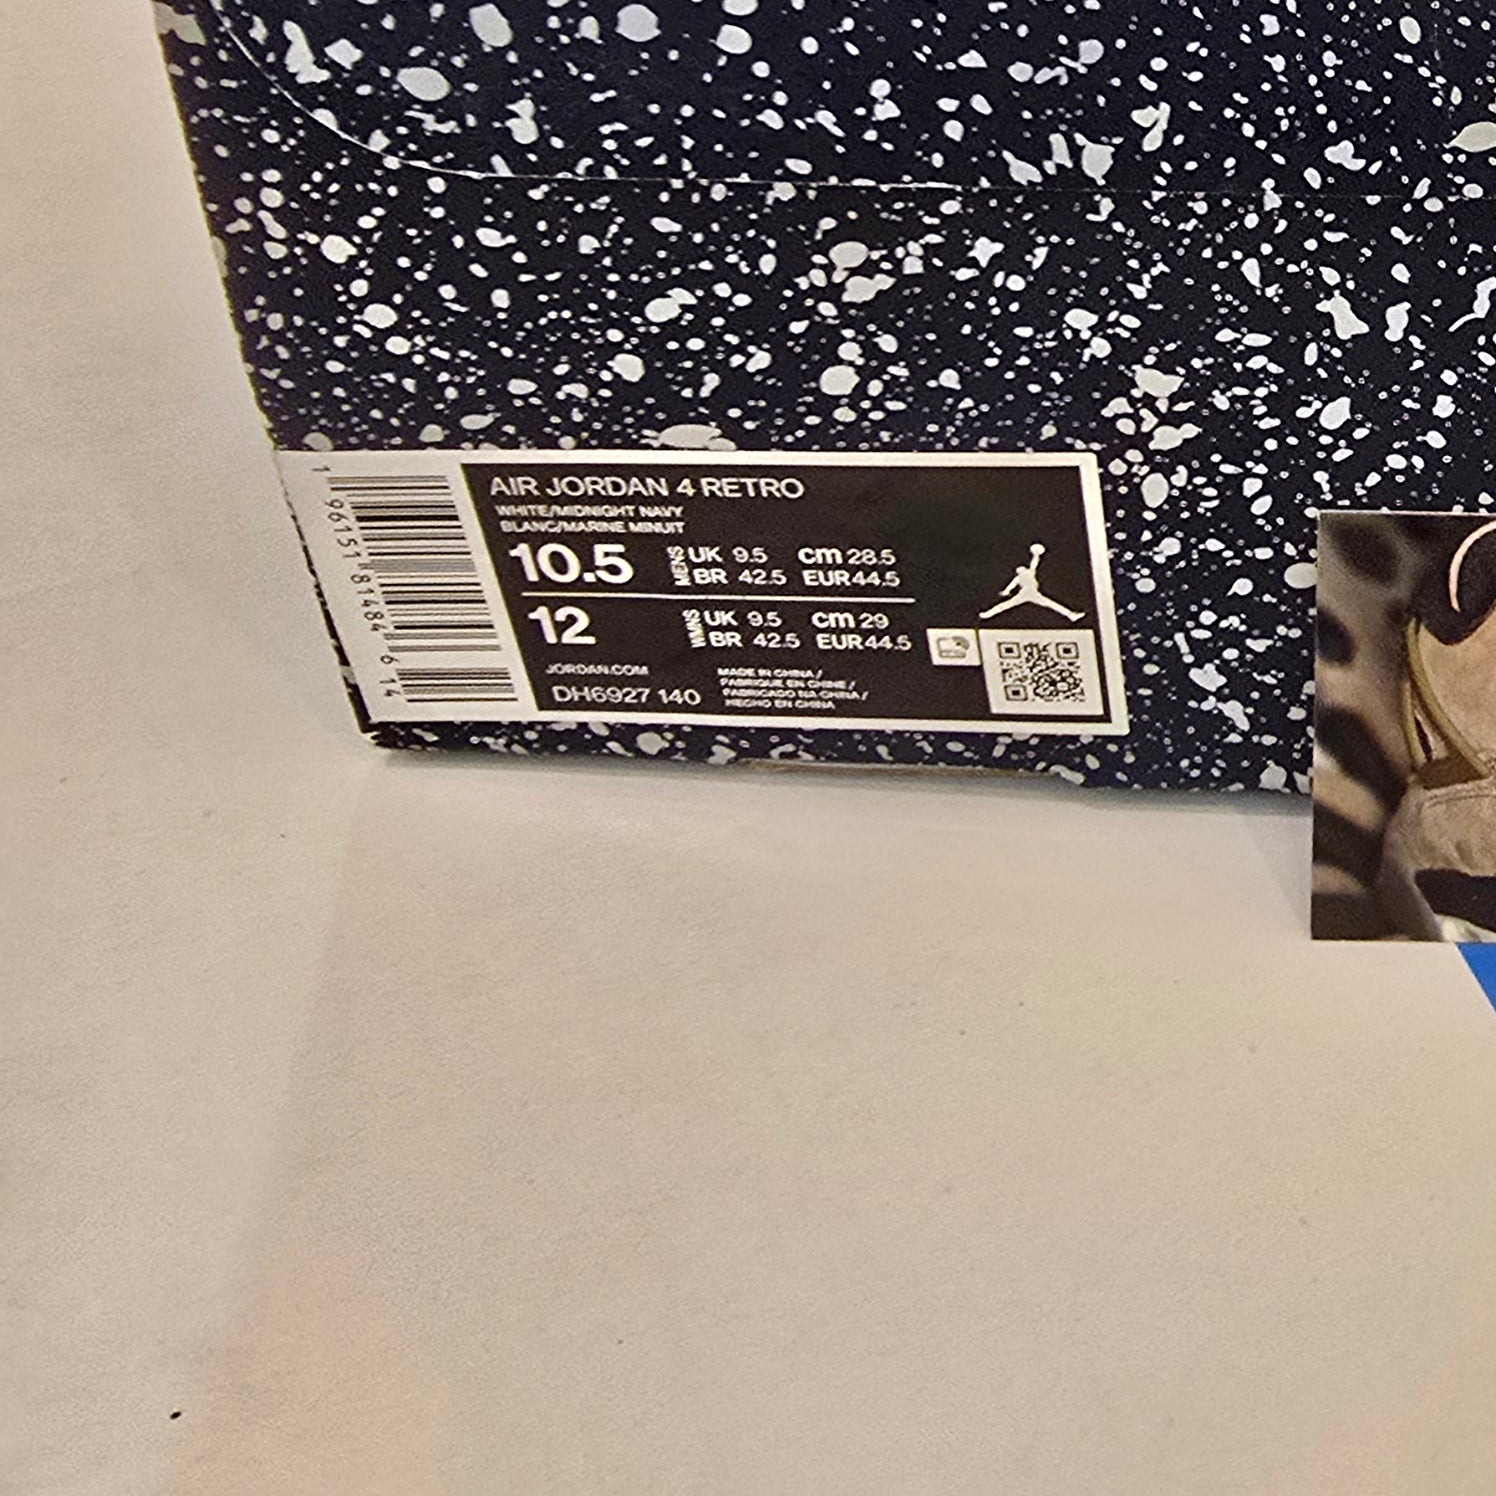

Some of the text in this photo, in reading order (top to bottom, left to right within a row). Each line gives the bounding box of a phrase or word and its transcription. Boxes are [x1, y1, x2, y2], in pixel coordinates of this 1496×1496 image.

[490, 476, 805, 499] AIR JORDAN 4 RETRO
[495, 505, 684, 518] WHITE/MIDNIGHT NAVY
[501, 520, 686, 534] BLANC/MARINE MINUIT
[509, 542, 634, 584] 10.5
[688, 546, 723, 562] UK
[732, 547, 768, 564] 9.5
[848, 548, 896, 566] 28.5
[692, 568, 728, 584] BR
[738, 569, 787, 585] 42.5
[802, 569, 851, 586] EUR
[529, 605, 597, 645] 12
[703, 610, 738, 626] UK
[747, 611, 783, 628] 9.5
[858, 613, 889, 629] 29
[708, 631, 743, 648] BR
[753, 632, 801, 649] 42.5
[816, 633, 864, 650] EUR
[545, 664, 650, 676] JORDAN.COM
[552, 685, 701, 705] DH6927 140
